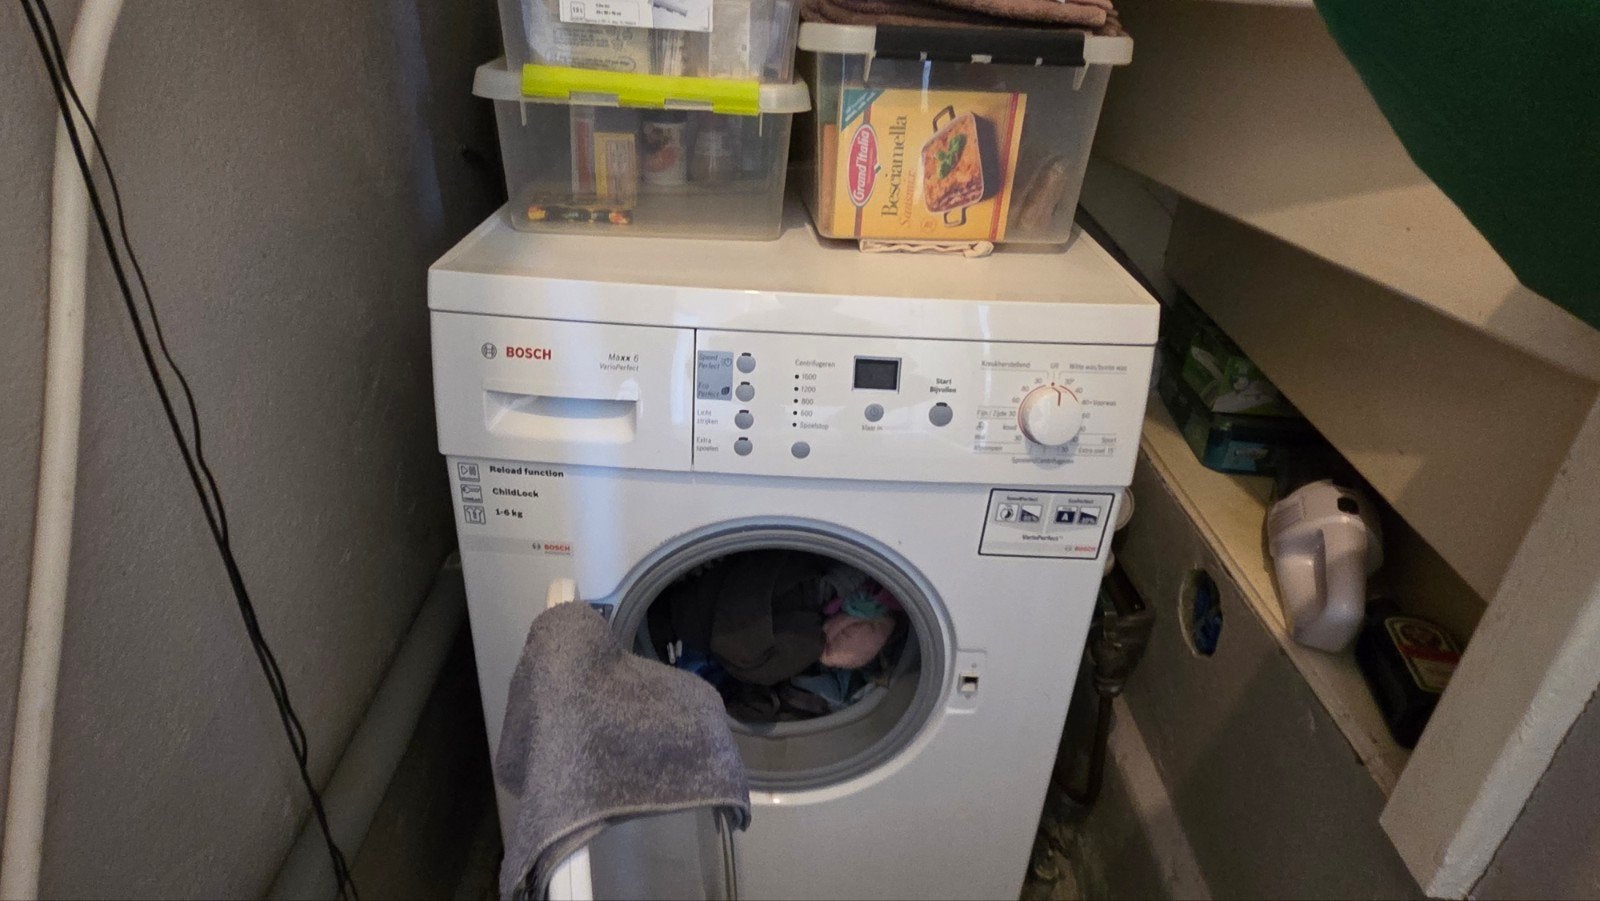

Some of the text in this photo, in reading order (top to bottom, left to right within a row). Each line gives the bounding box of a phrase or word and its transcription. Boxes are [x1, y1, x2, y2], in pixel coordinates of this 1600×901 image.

[853, 130, 870, 201] Grand'Italia
[881, 115, 907, 216] Besciamella
[505, 346, 552, 360] BOSCH
[608, 353, 639, 362] Maxx 6
[600, 363, 639, 372] VarioPerfect
[699, 362, 720, 370] Perfect
[801, 385, 816, 393] 1200
[489, 465, 564, 477] Reload function
[492, 487, 539, 498] ChildLock
[495, 508, 523, 518] 1-6 kg
[1061, 512, 1069, 520] A
[544, 544, 570, 552] BOSCH
